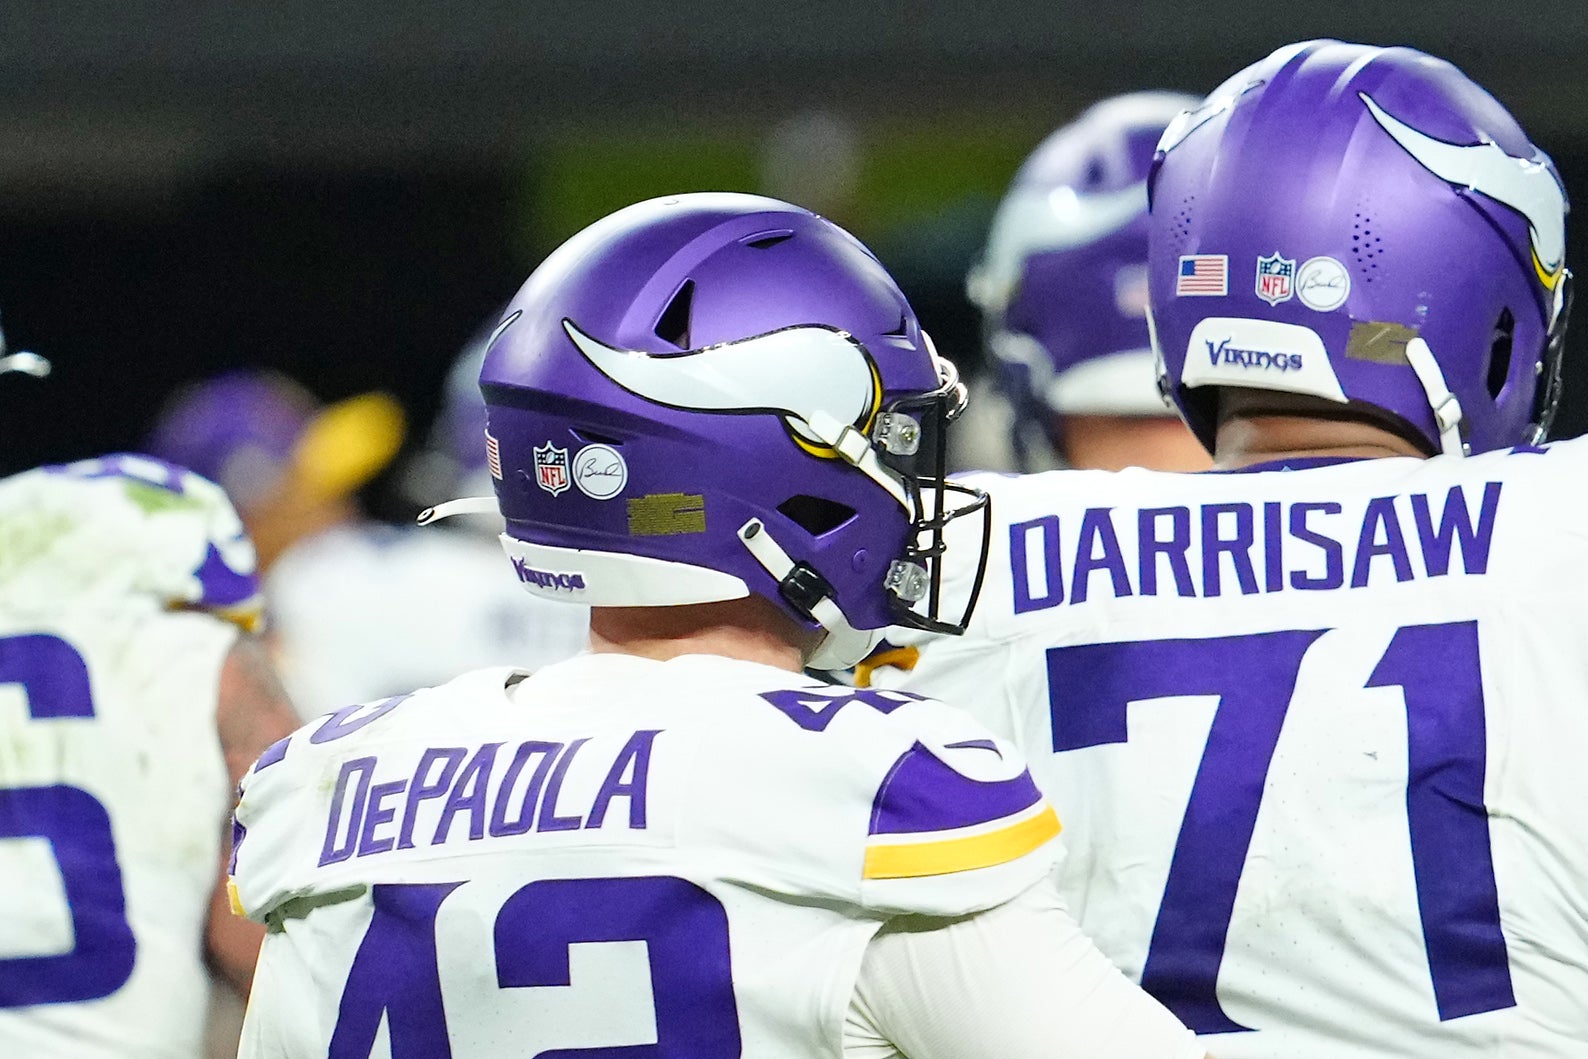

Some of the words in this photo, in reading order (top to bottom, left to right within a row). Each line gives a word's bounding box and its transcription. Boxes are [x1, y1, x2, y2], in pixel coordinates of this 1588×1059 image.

[1261, 275, 1289, 297] NFL
[540, 466, 567, 488] NFL
[1009, 481, 1503, 615] DARRISAW
[317, 729, 666, 868] DEPAOLA
[1045, 620, 1517, 1036] 71
